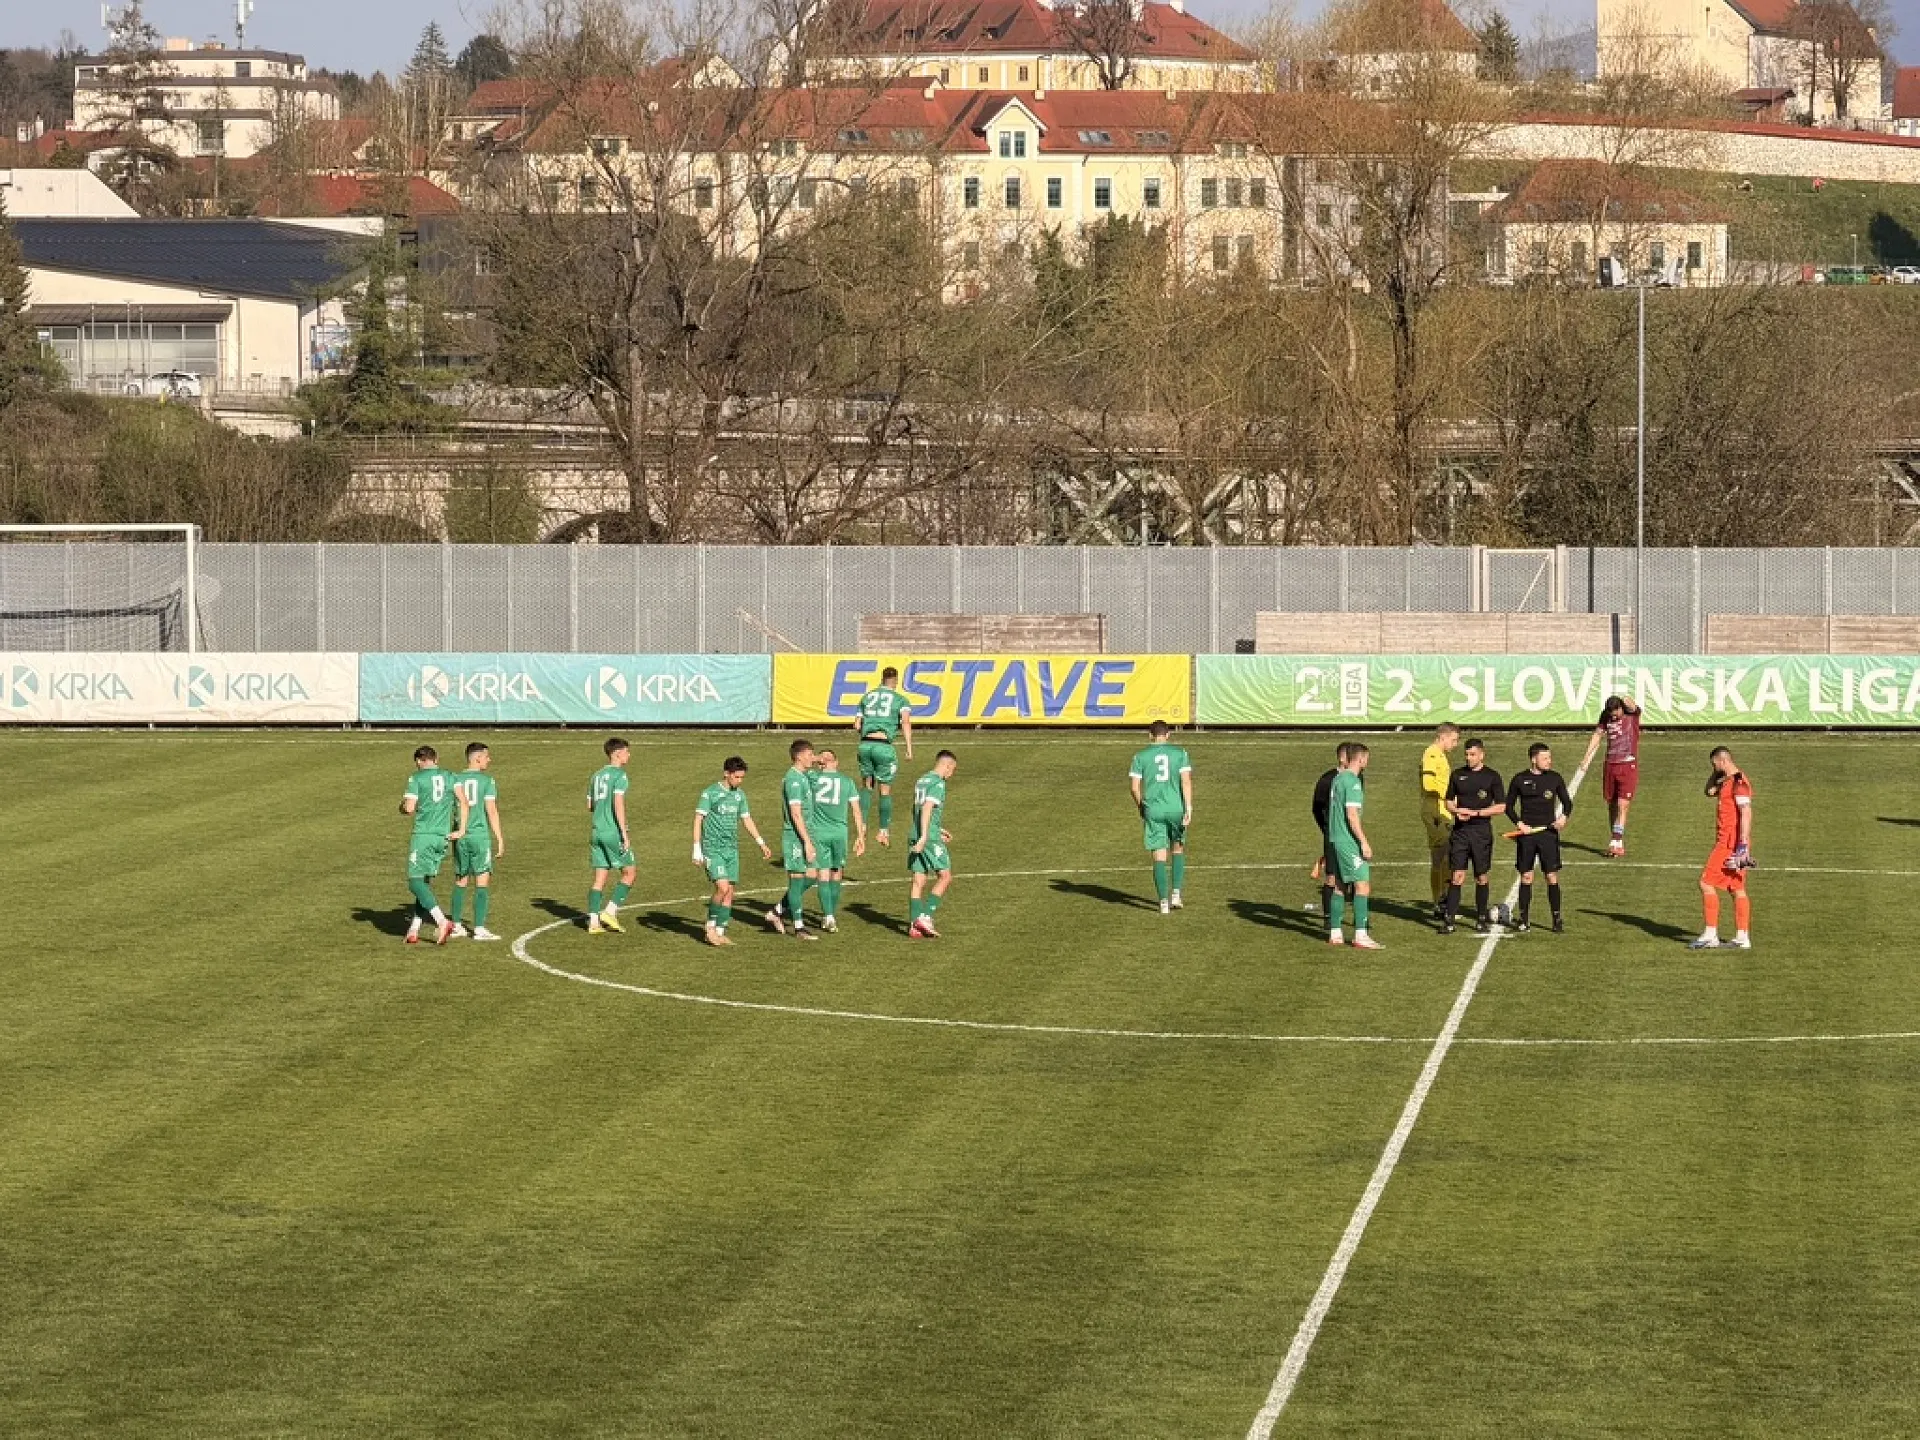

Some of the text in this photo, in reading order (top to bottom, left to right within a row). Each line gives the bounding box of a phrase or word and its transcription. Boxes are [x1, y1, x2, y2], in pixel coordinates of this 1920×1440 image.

[50, 673, 134, 700] KRKA
[225, 673, 310, 700] KRKA
[459, 672, 545, 702] KRKA
[637, 673, 722, 703] KRKA
[1345, 667, 1362, 711] LIGA
[1384, 668, 1432, 712] 2.
[864, 692, 894, 717] 23
[1154, 754, 1169, 783] 3
[432, 775, 445, 803] 8
[815, 777, 841, 806] 21
